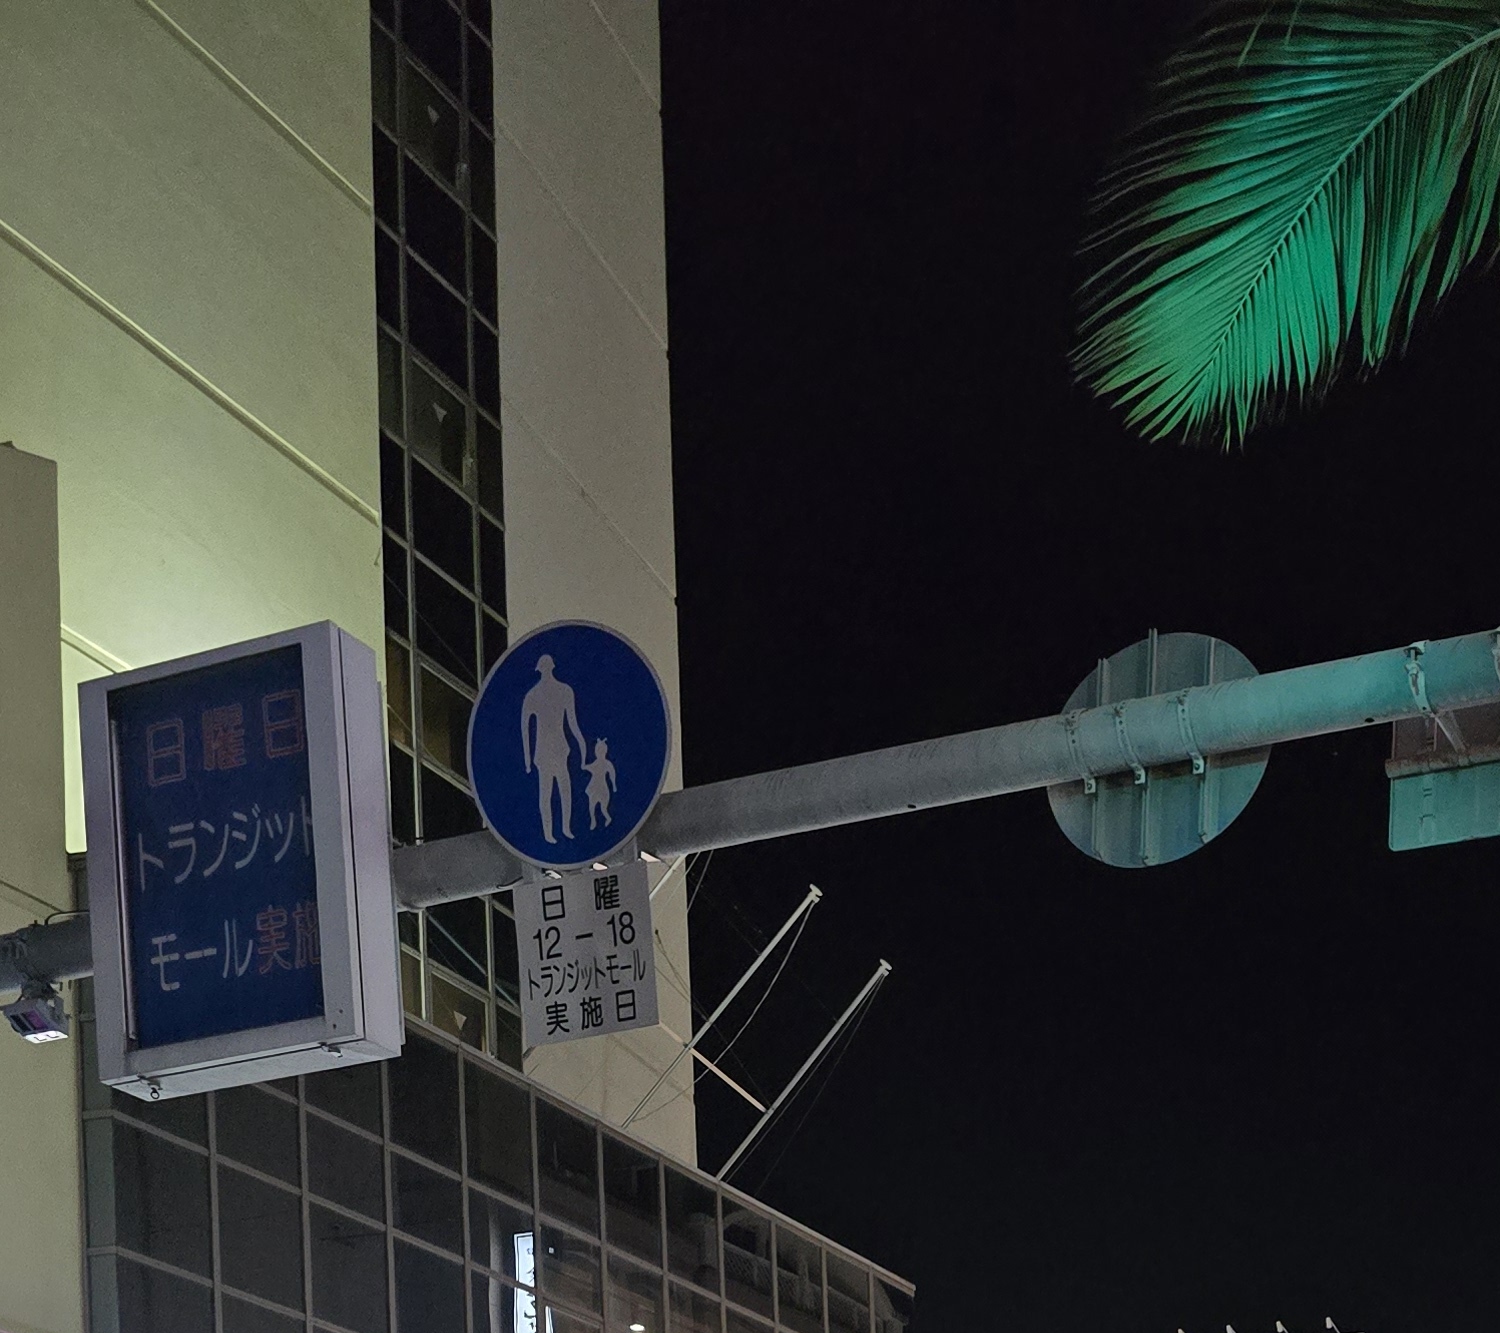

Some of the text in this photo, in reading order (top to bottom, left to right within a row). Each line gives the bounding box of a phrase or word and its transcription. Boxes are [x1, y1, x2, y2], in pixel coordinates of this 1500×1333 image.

[146, 689, 304, 787] 日曜日
[541, 874, 621, 922] 日曜
[527, 948, 646, 1001] トランジットモール
[545, 988, 637, 1036] 実施日
